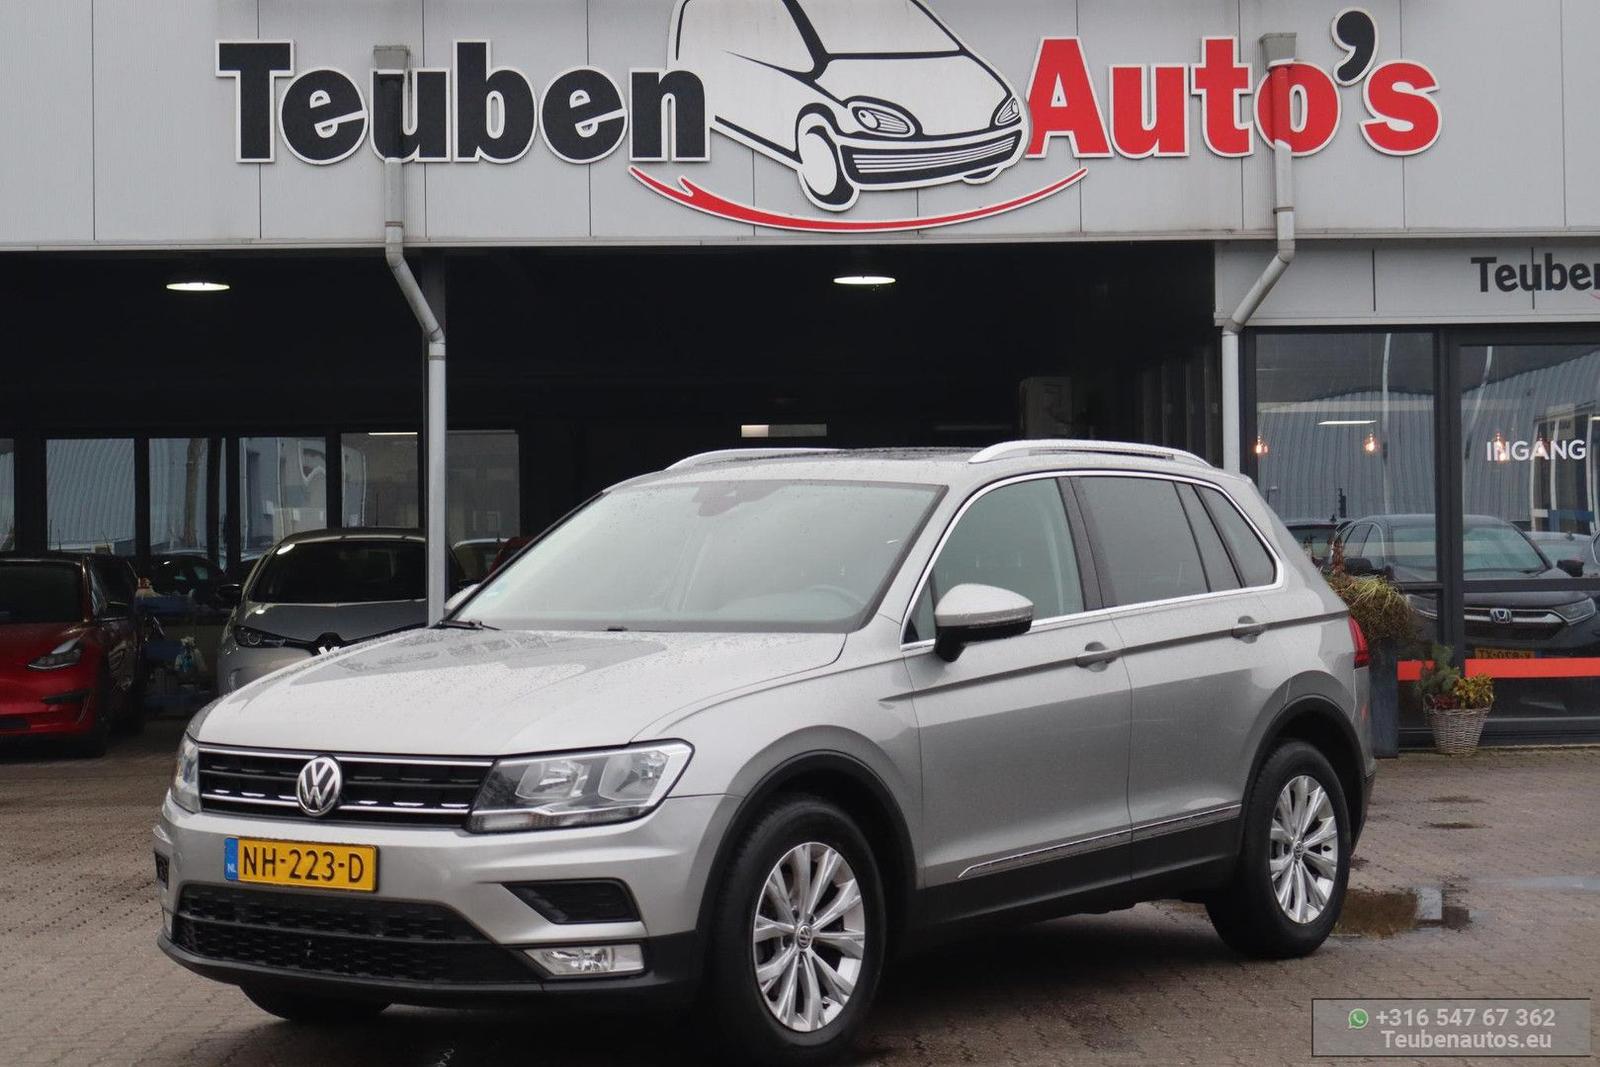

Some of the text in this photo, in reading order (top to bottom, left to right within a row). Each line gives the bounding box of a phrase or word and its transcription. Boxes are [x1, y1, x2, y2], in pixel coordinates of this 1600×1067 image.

[216, 8, 1441, 163] Teuben Auto's
[1486, 440, 1586, 461] INGANG
[243, 846, 364, 883] NH-223-D
